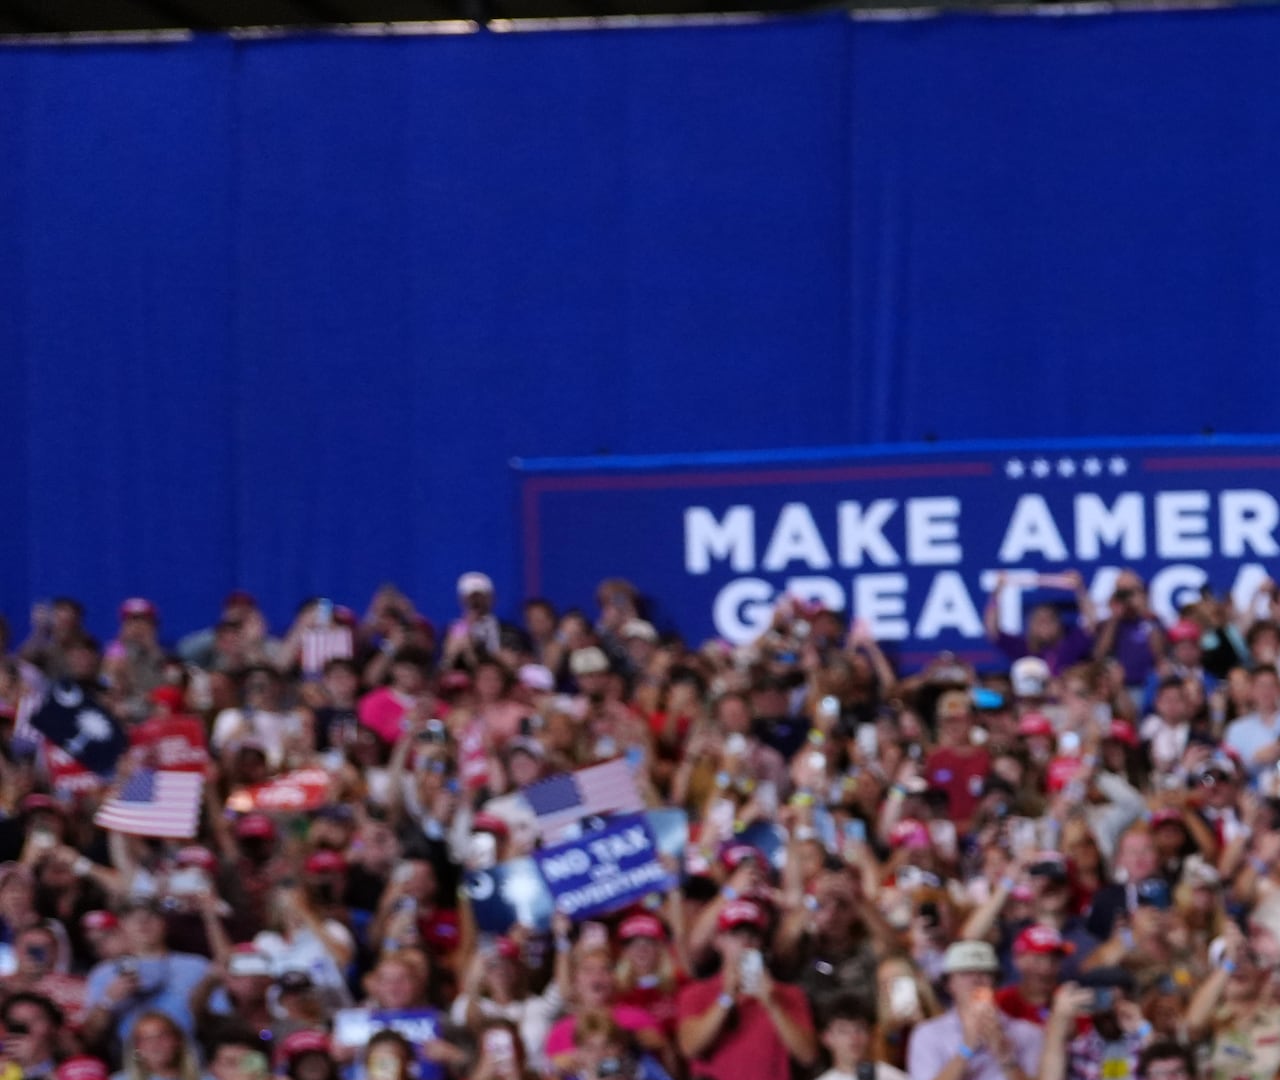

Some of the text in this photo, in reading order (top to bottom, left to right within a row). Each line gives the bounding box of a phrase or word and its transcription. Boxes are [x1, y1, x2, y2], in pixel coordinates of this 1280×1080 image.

[684, 496, 963, 574] MAKE
[541, 847, 591, 882] NO
[588, 825, 650, 863] TAX
